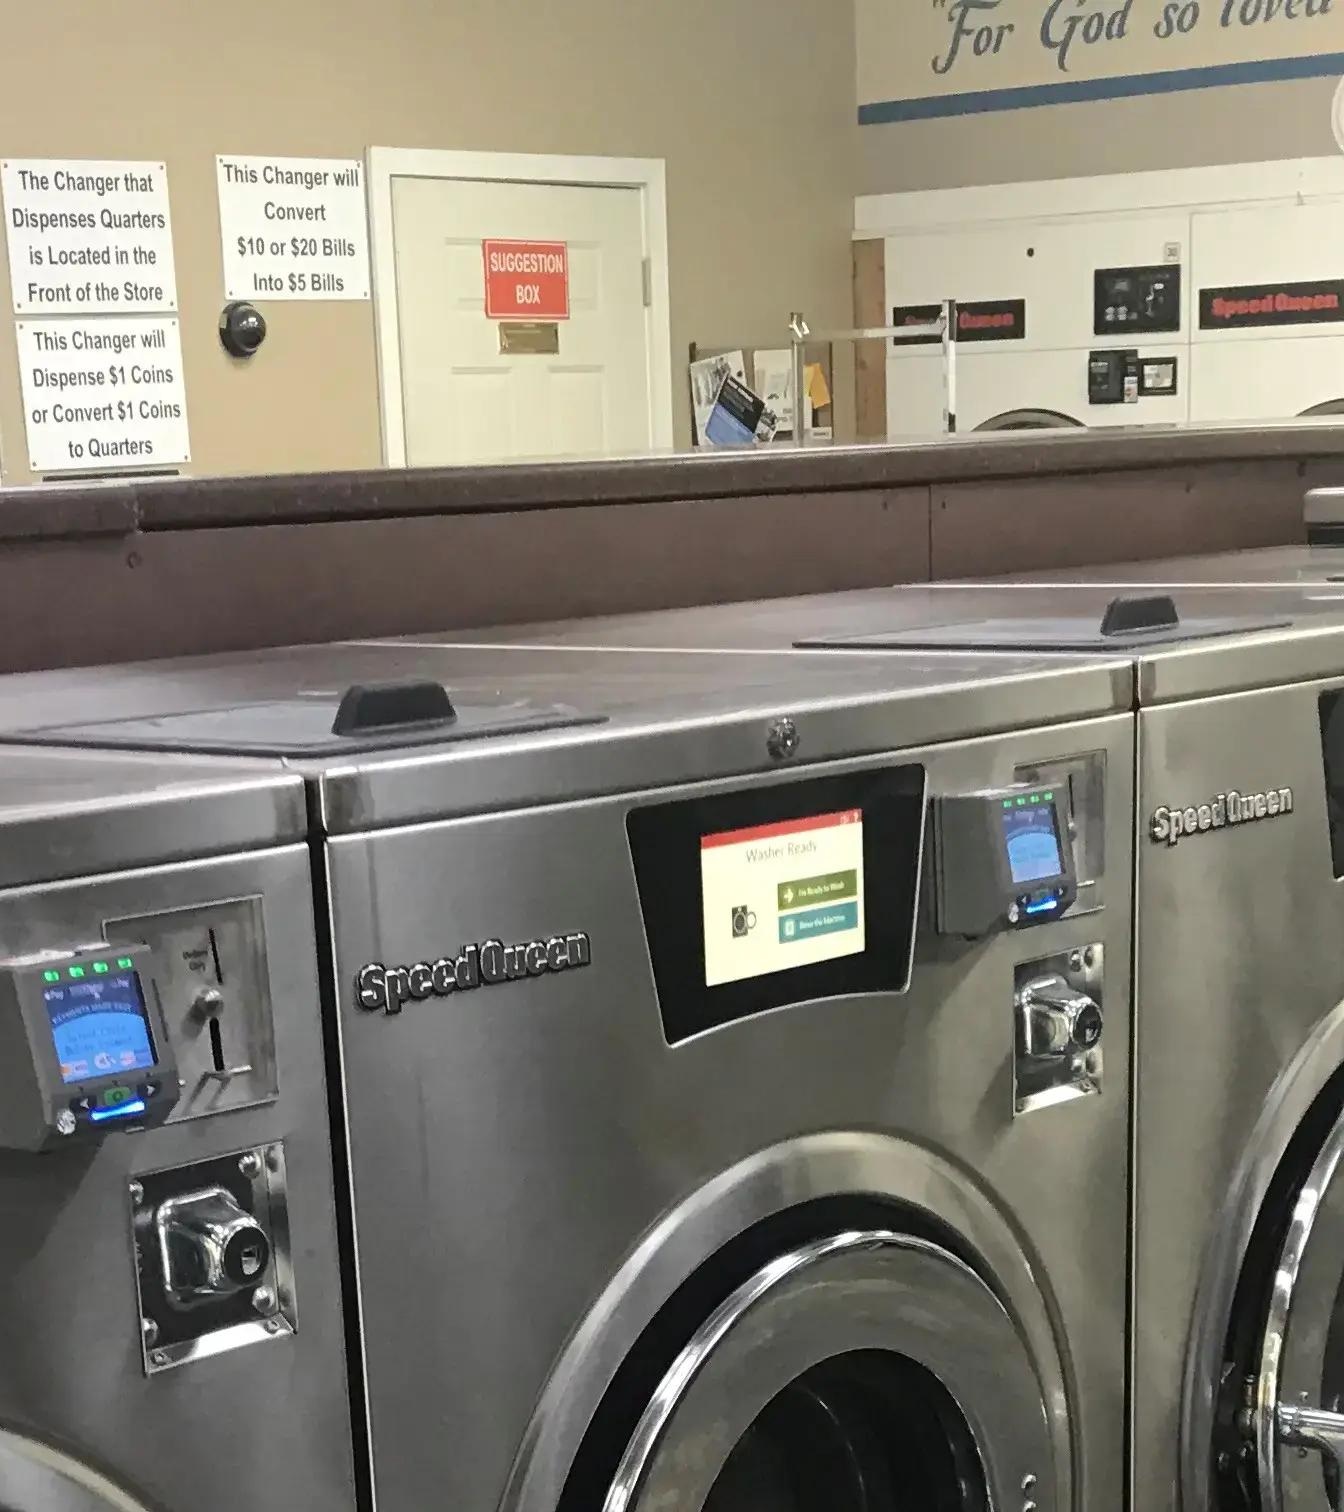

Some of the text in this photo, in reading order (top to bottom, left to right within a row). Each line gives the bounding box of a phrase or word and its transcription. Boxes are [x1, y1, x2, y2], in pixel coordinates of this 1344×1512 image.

[1040, 0, 1133, 72] God
[1153, 2, 1200, 39] so
[18, 171, 153, 196] The Changer that
[223, 164, 359, 190] This Changer will
[12, 208, 165, 232] Dispenses Quarters
[264, 201, 326, 221] Convert
[29, 245, 156, 265] is Located in the
[237, 236, 355, 258] $10 or $20 Bills
[490, 252, 563, 273] SUGGESTION
[28, 282, 163, 302] Front of the Store
[254, 272, 344, 292] Into $5 Bills
[516, 284, 540, 304] BOX
[1212, 293, 1338, 318] Speed Queen
[33, 329, 165, 353] This Changer will
[33, 365, 174, 391] Dispense $1 Coins
[32, 400, 181, 424] or Convert $1 Coins
[68, 438, 153, 458] to Quarters
[1151, 787, 1293, 846] Speed Queen
[746, 840, 817, 863] Washer Ready
[355, 932, 592, 1015] Speed Queen
